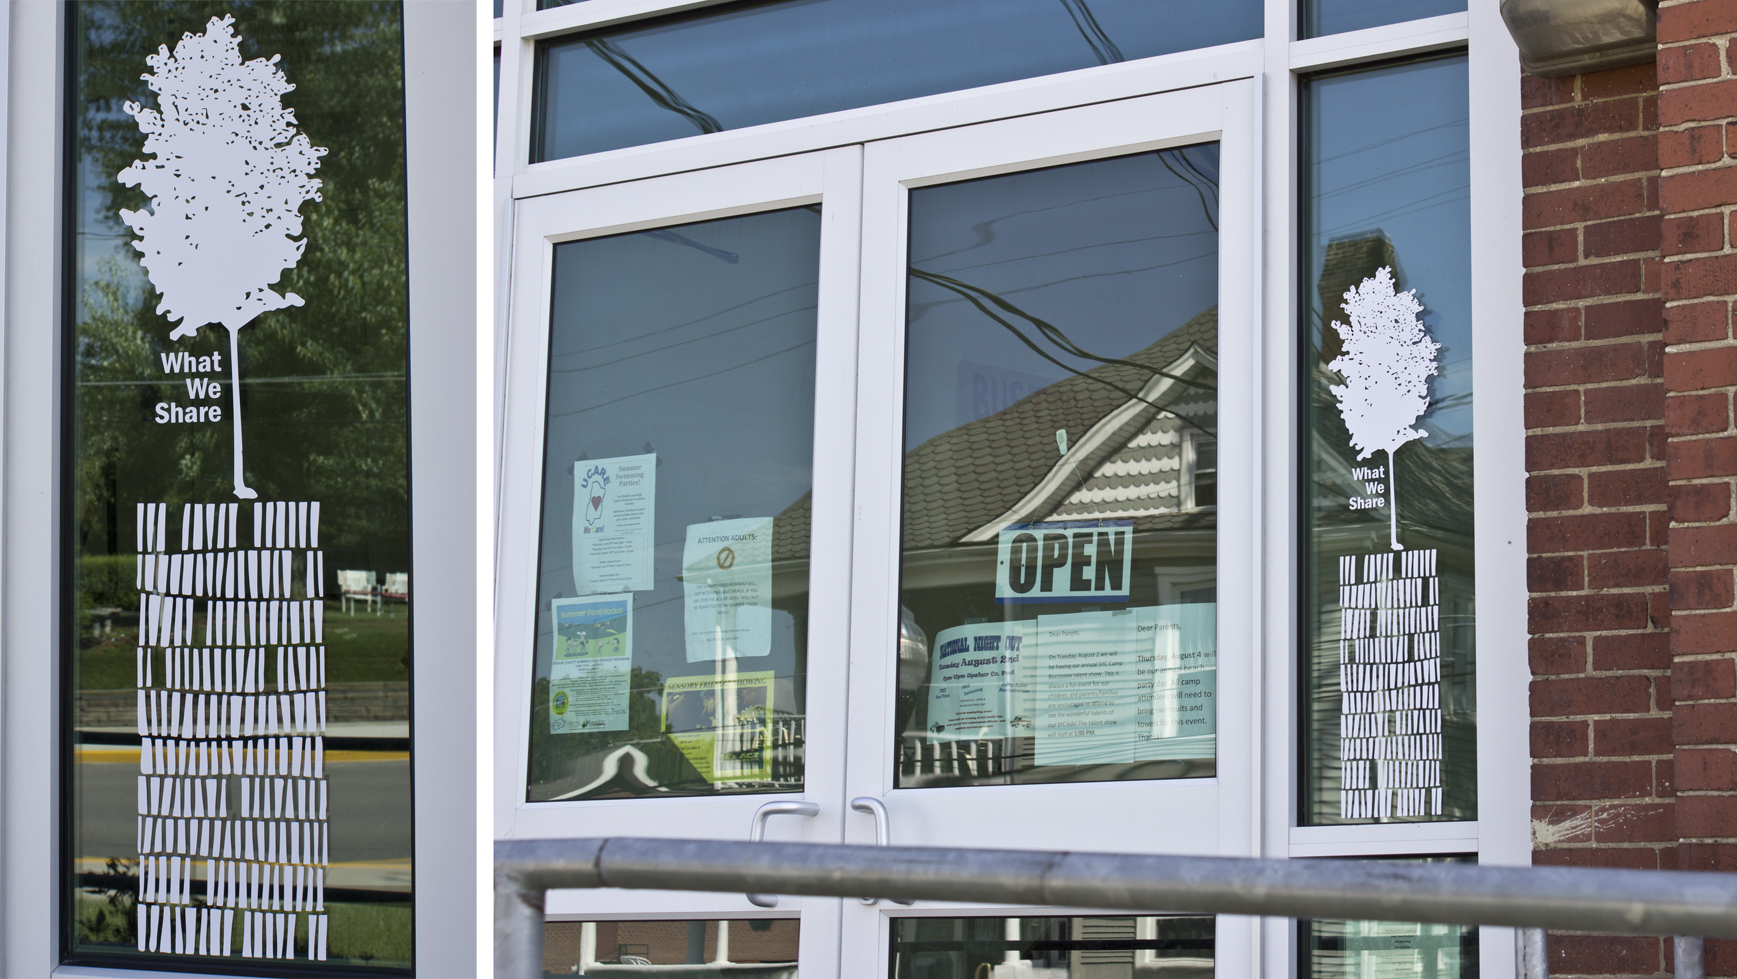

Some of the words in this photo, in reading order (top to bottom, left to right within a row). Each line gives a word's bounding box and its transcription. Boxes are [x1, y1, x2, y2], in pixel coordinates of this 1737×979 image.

[161, 351, 222, 373] What
[186, 378, 221, 399] We
[155, 402, 221, 424] Share
[616, 472, 644, 480] Swimming
[1352, 466, 1385, 480] What
[1365, 481, 1385, 495] We
[1349, 497, 1385, 510] Share
[697, 535, 730, 544] ATTENTION
[1009, 531, 1126, 594] OPEN
[561, 610, 586, 619] Summer
[1137, 624, 1153, 633] Dear
[1154, 623, 1181, 631] Parents,
[939, 637, 970, 660] NATIONAL
[973, 635, 1001, 651] NIGHT
[1005, 635, 1023, 652] OUT
[961, 656, 998, 667] August
[1000, 654, 1020, 663] 2nd
[1137, 654, 1169, 662] Thursday,
[1171, 651, 1195, 661] August
[1203, 650, 1216, 658] will
[1160, 665, 1182, 674] annual
[1183, 664, 1205, 672] beach
[668, 682, 699, 690] SENSORY
[1137, 681, 1154, 690] party
[1156, 680, 1169, 688] day.
[1181, 678, 1201, 686] camp
[964, 688, 983, 696] Swimming
[1137, 693, 1169, 702] attendees
[1184, 691, 1202, 699] need
[1155, 705, 1188, 713] swimsuits
[1137, 720, 1158, 728] towels
[1171, 718, 1184, 726] this
[1185, 717, 1207, 725] event.
[1138, 733, 1162, 741] Thanks!
